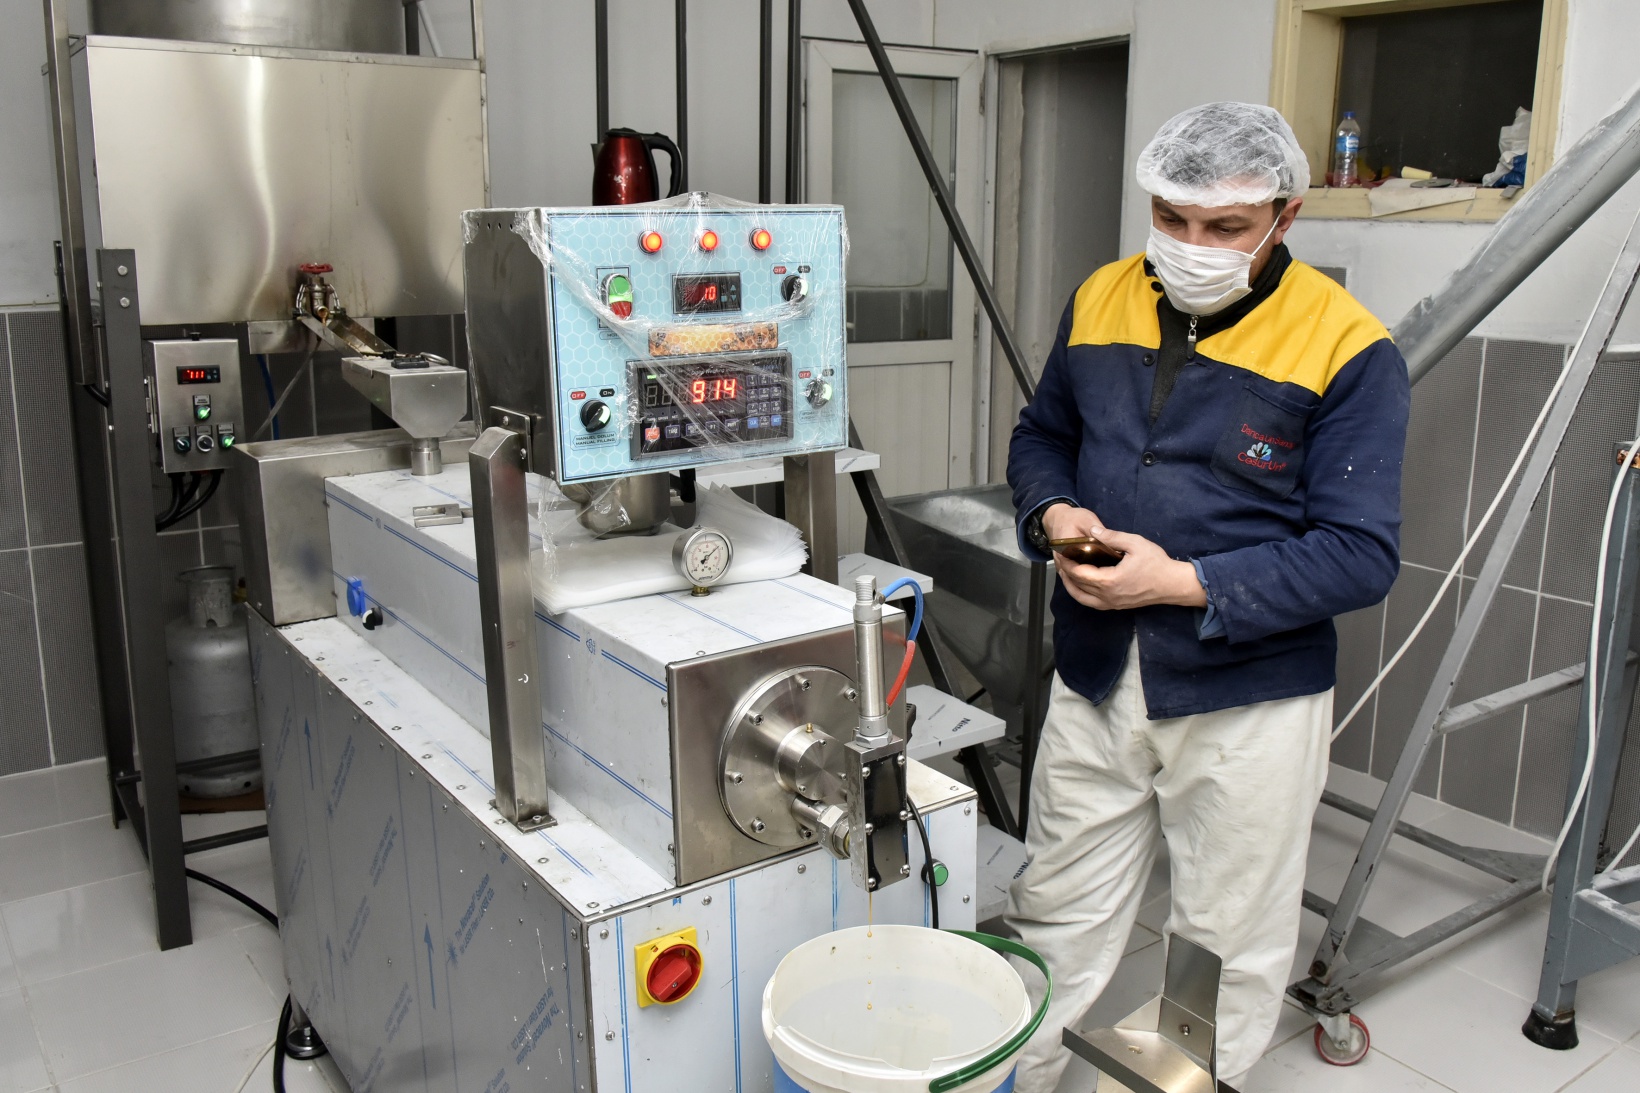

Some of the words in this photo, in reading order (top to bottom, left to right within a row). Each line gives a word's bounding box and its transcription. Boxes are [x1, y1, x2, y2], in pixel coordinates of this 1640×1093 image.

[705, 286, 716, 300] 10
[693, 379, 736, 403] 914
[952, 717, 971, 732] Nitto
[1013, 861, 1029, 880] Nitto
